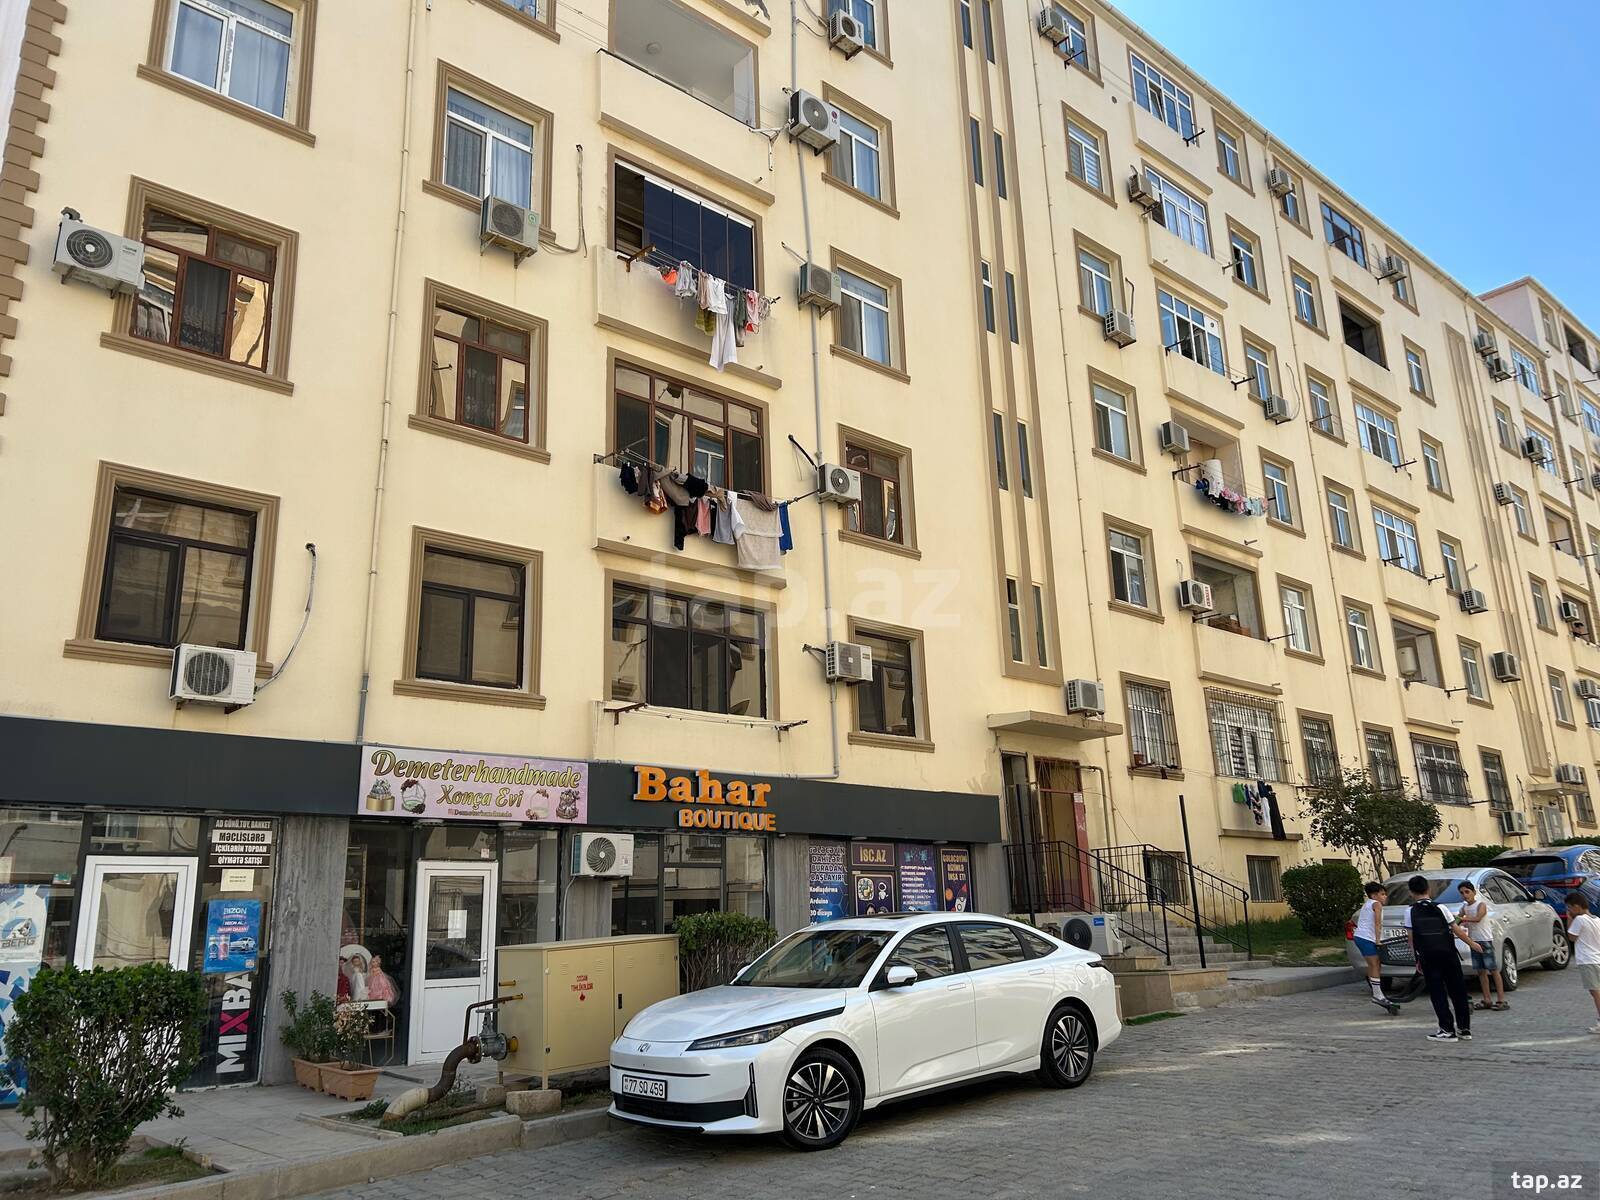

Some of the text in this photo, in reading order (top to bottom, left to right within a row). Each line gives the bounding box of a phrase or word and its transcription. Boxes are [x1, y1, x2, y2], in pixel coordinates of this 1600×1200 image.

[371, 749, 582, 788] Demeterhandmade
[436, 785, 524, 810] Xonça Evi
[633, 765, 771, 807] Bahar
[679, 808, 776, 831] BOUTIQUE
[811, 863, 844, 873] BURADAN
[629, 1079, 638, 1092] 77
[650, 1082, 664, 1096] 459
